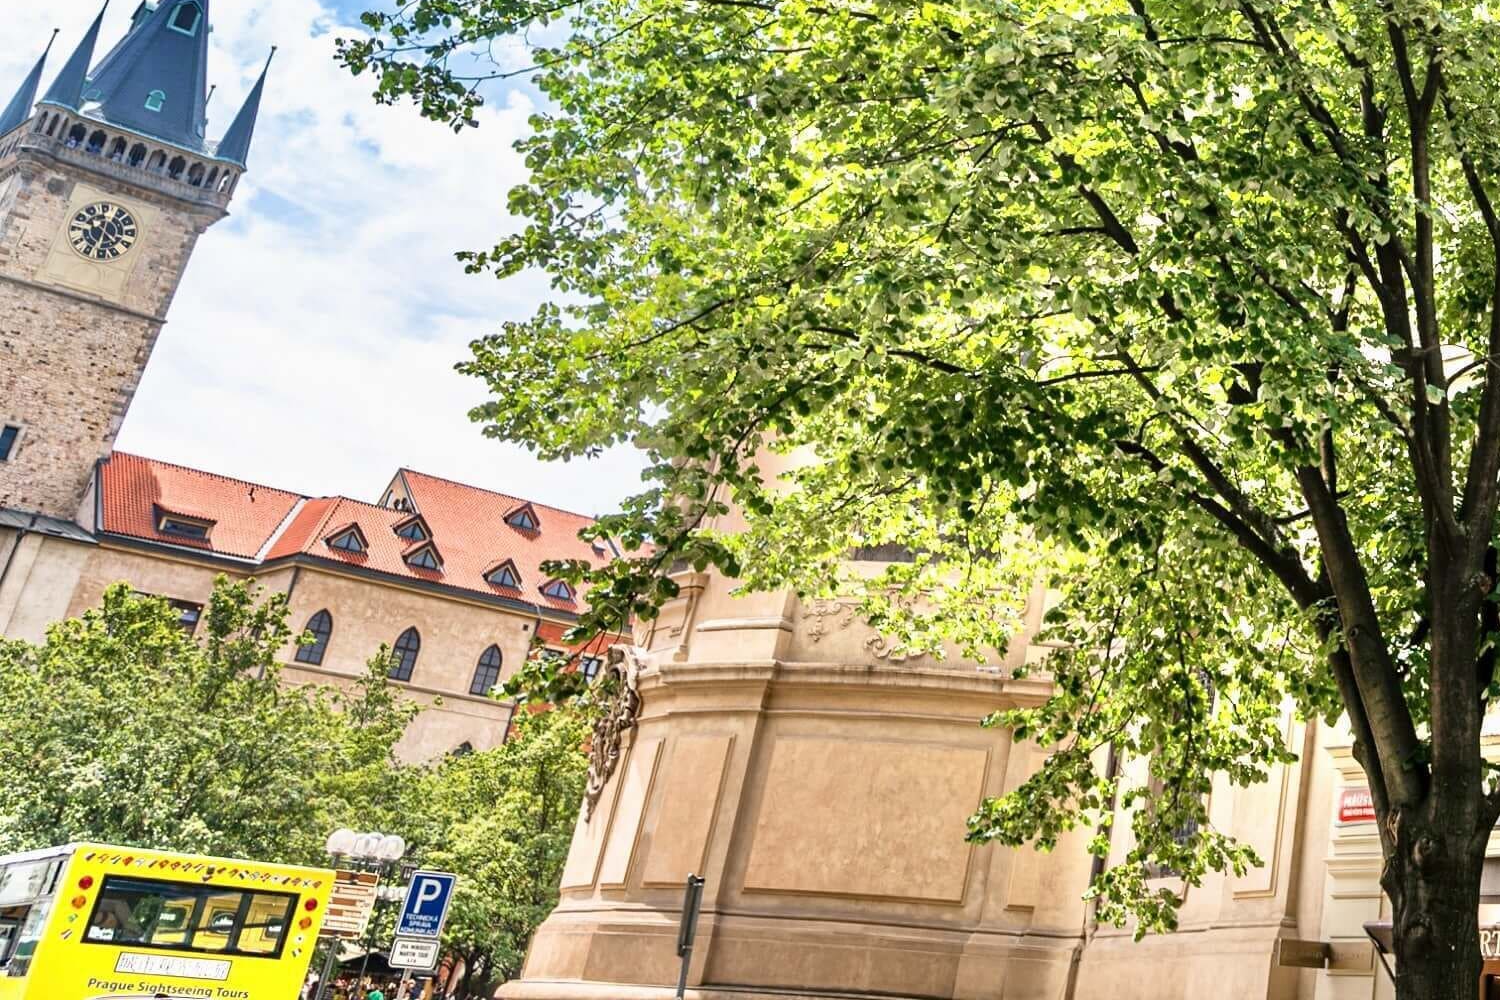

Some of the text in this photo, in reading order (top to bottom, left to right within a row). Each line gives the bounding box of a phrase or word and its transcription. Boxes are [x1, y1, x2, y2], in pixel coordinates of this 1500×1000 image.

[413, 878, 442, 913] P
[87, 978, 249, 999] Prague Sightseeing Tours
